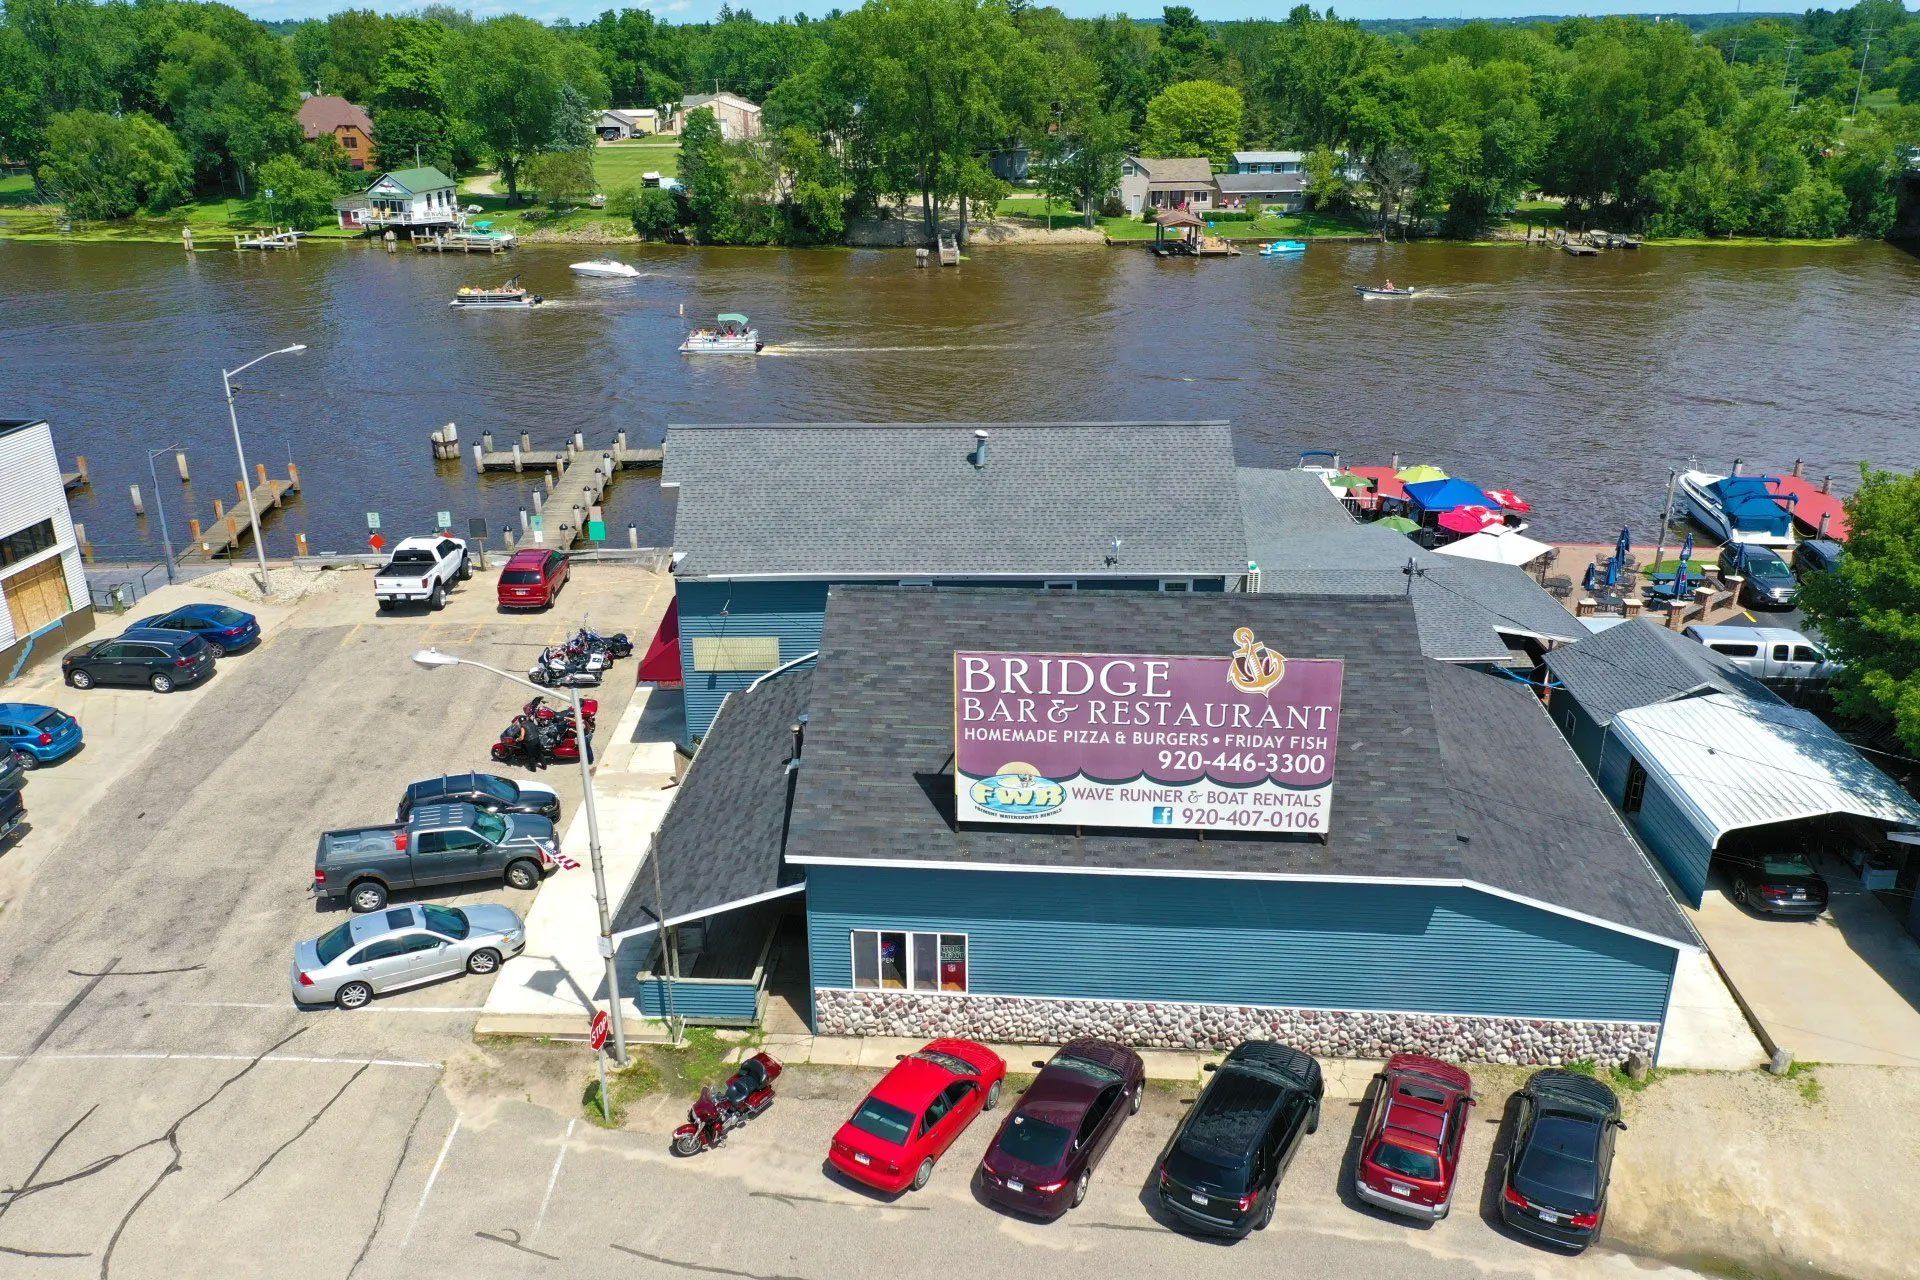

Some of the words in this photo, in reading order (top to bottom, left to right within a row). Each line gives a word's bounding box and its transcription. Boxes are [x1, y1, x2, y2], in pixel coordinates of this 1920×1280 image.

[962, 657, 1171, 698] BRIDGE
[963, 697, 1038, 723] BAR
[1047, 699, 1079, 723] &
[1088, 700, 1333, 730] RESTAURANT
[964, 728, 1057, 743] HOMEMADE
[1063, 730, 1110, 744] PIZZA
[1115, 732, 1126, 744] &
[1133, 732, 1208, 746] BURGERS
[1225, 734, 1285, 749] FRIDAY
[1290, 736, 1327, 750] FISH
[1158, 750, 1325, 774] 920-446-3300
[973, 784, 1064, 807] FWR
[1072, 787, 1114, 801] WAVE
[1120, 789, 1183, 803] RUNNER
[1188, 790, 1203, 804] &
[1207, 791, 1249, 805] BOAT
[1253, 792, 1321, 807] RENTALS
[1040, 808, 1062, 818] RENTALS
[1182, 808, 1320, 828] 920-407-0106
[591, 1016, 607, 1045] STOP
